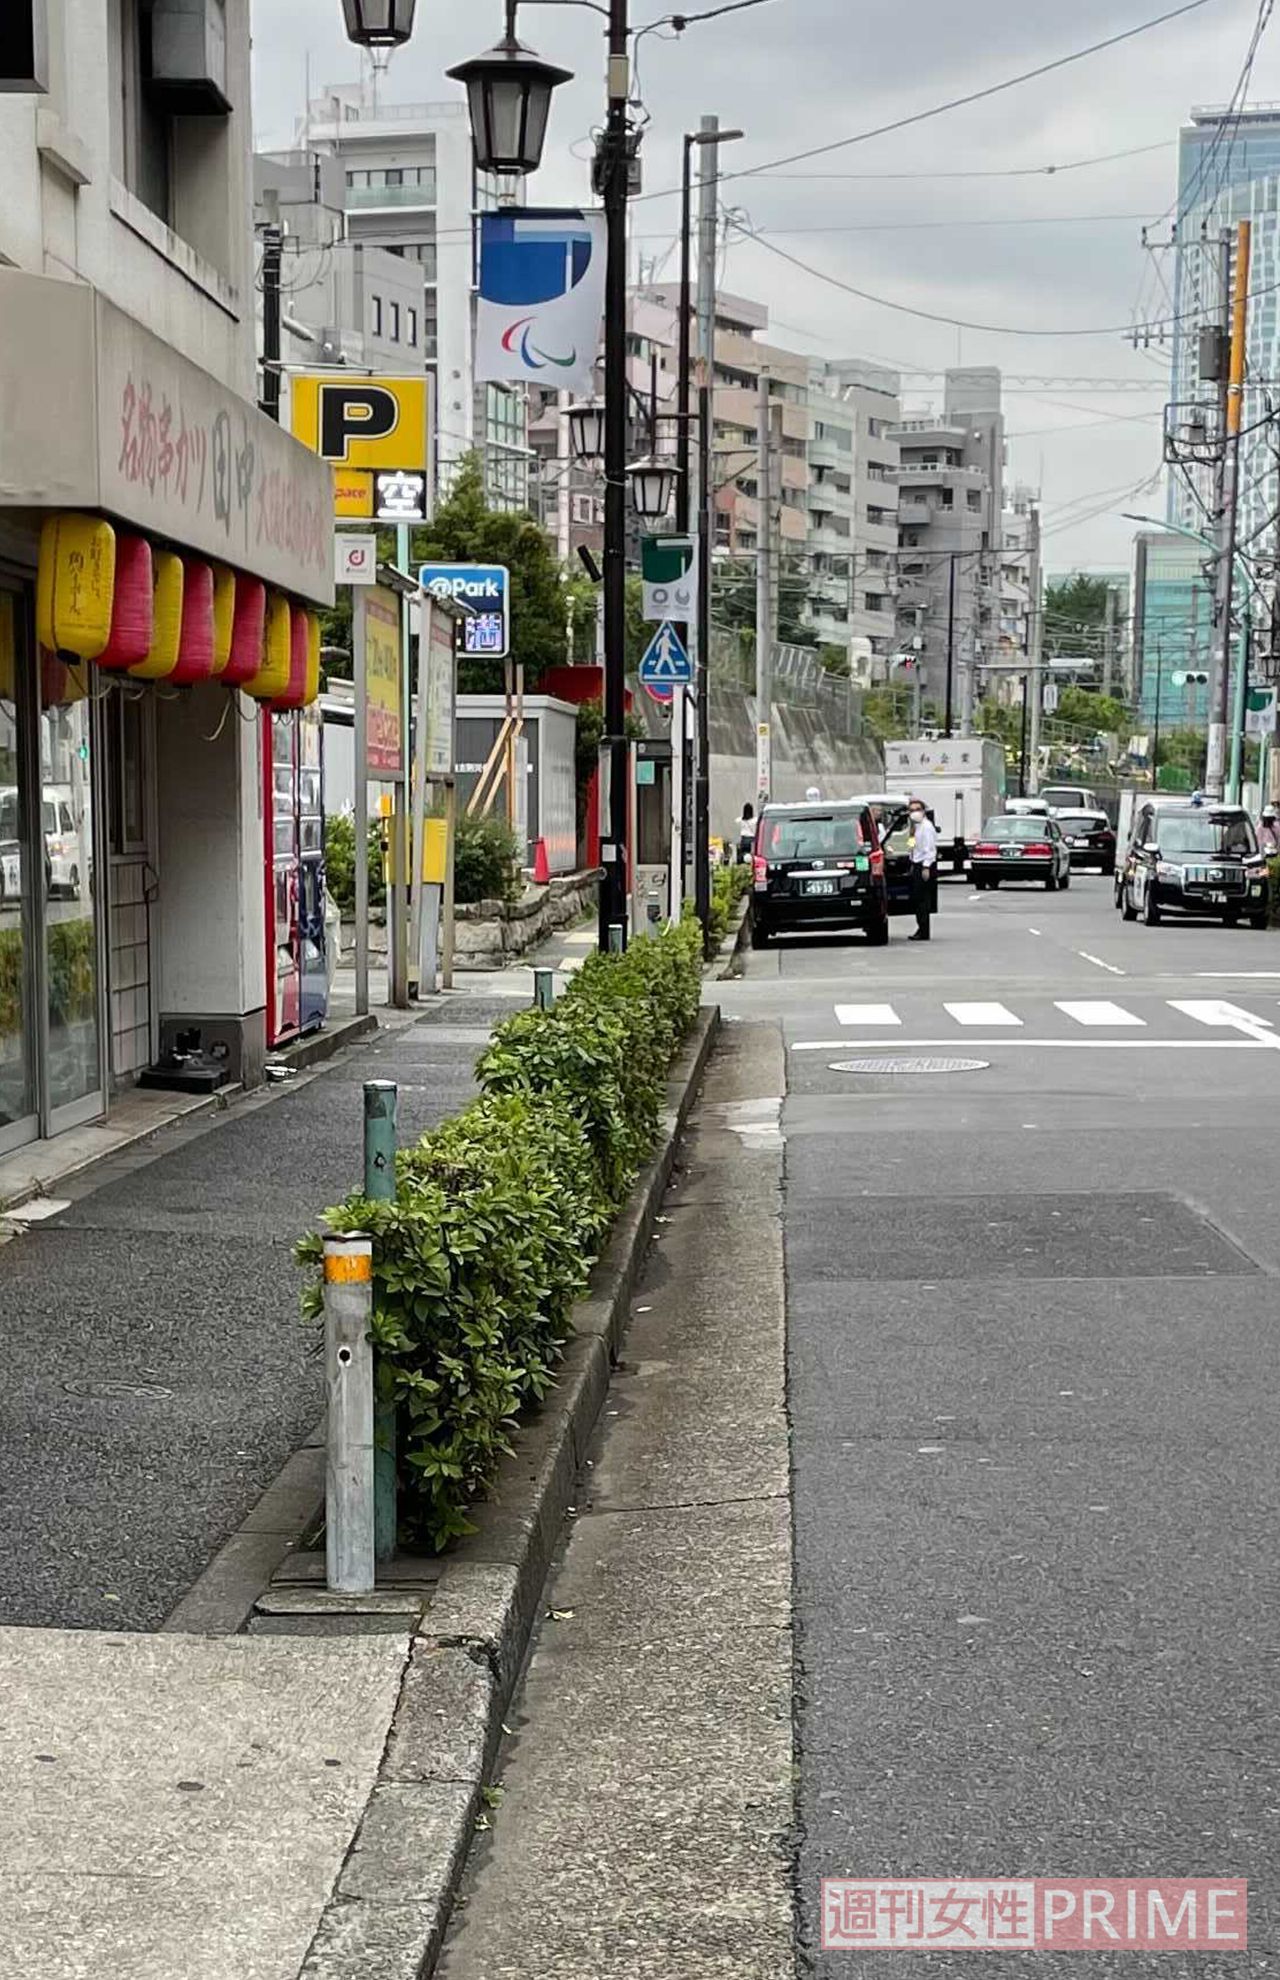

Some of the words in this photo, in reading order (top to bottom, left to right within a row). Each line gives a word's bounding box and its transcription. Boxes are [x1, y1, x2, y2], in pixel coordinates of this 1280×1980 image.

[319, 384, 398, 461] P
[377, 470, 424, 518] 空
[429, 576, 499, 599] @Park
